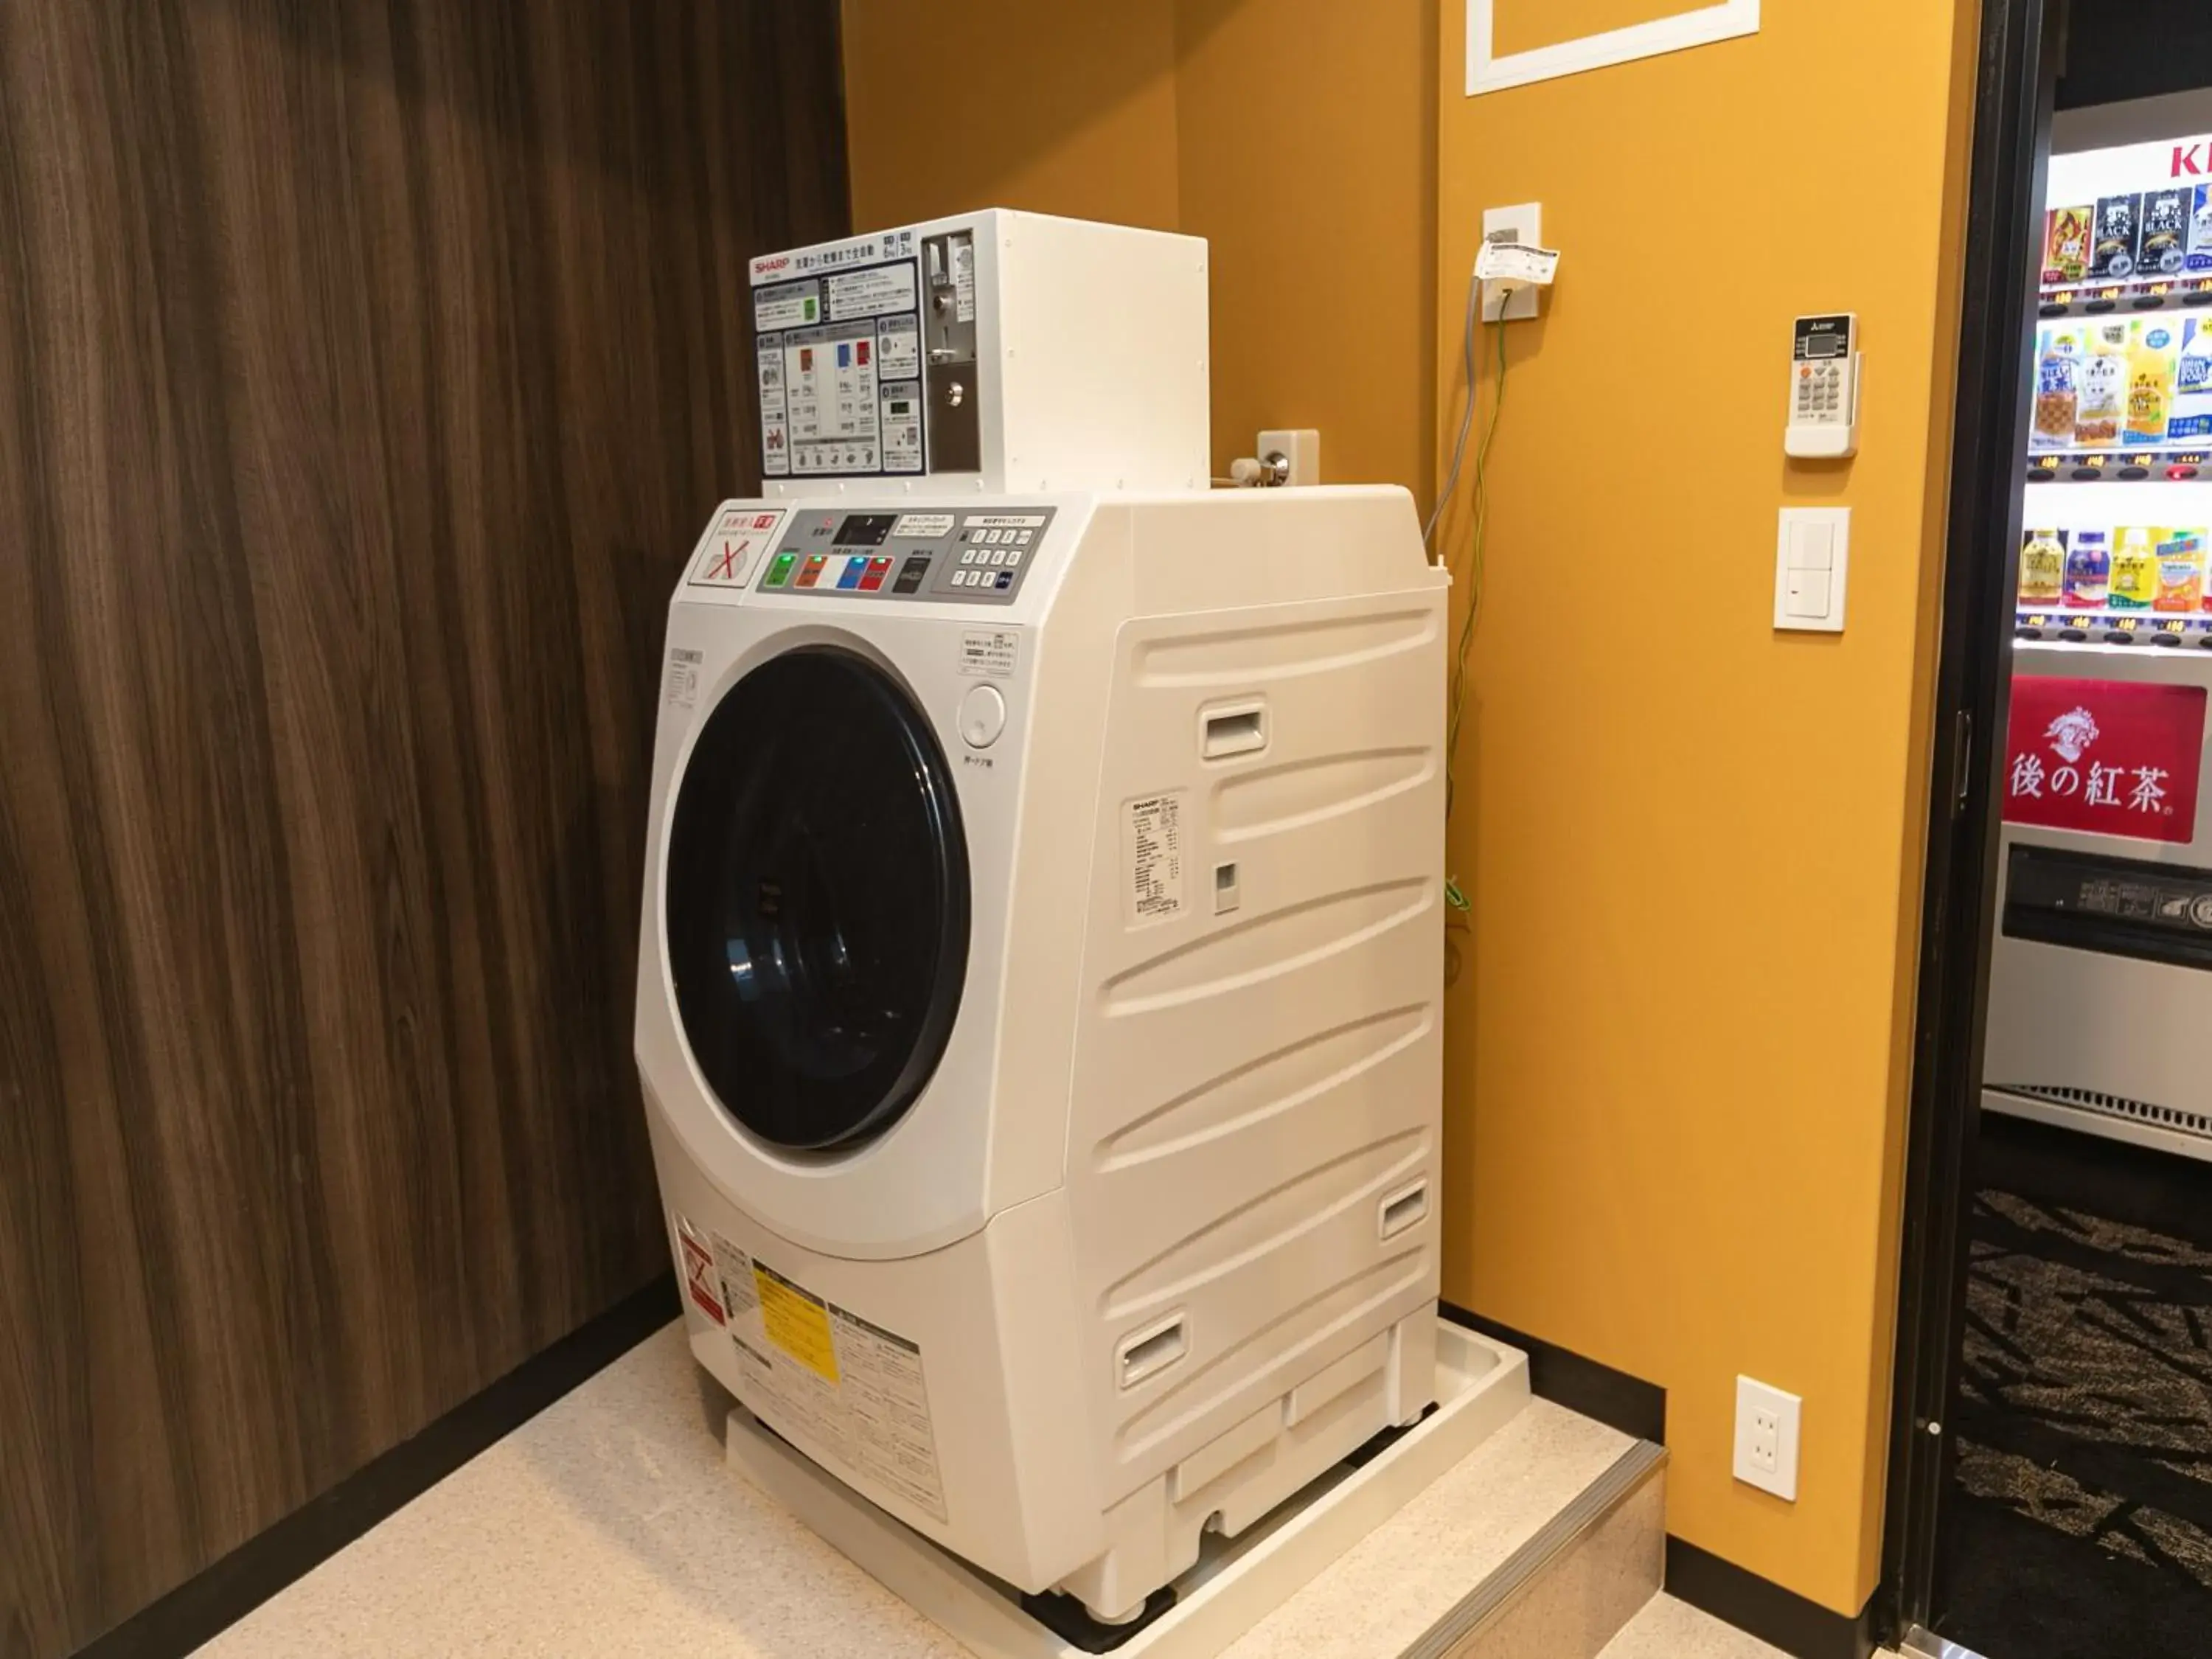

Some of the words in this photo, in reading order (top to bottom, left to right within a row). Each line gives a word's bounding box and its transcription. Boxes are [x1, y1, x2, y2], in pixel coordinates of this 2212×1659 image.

[755, 257, 790, 274] SHARP
[2011, 753, 2169, 813] 後の紅茶
[1133, 799, 1160, 810] SHARP
